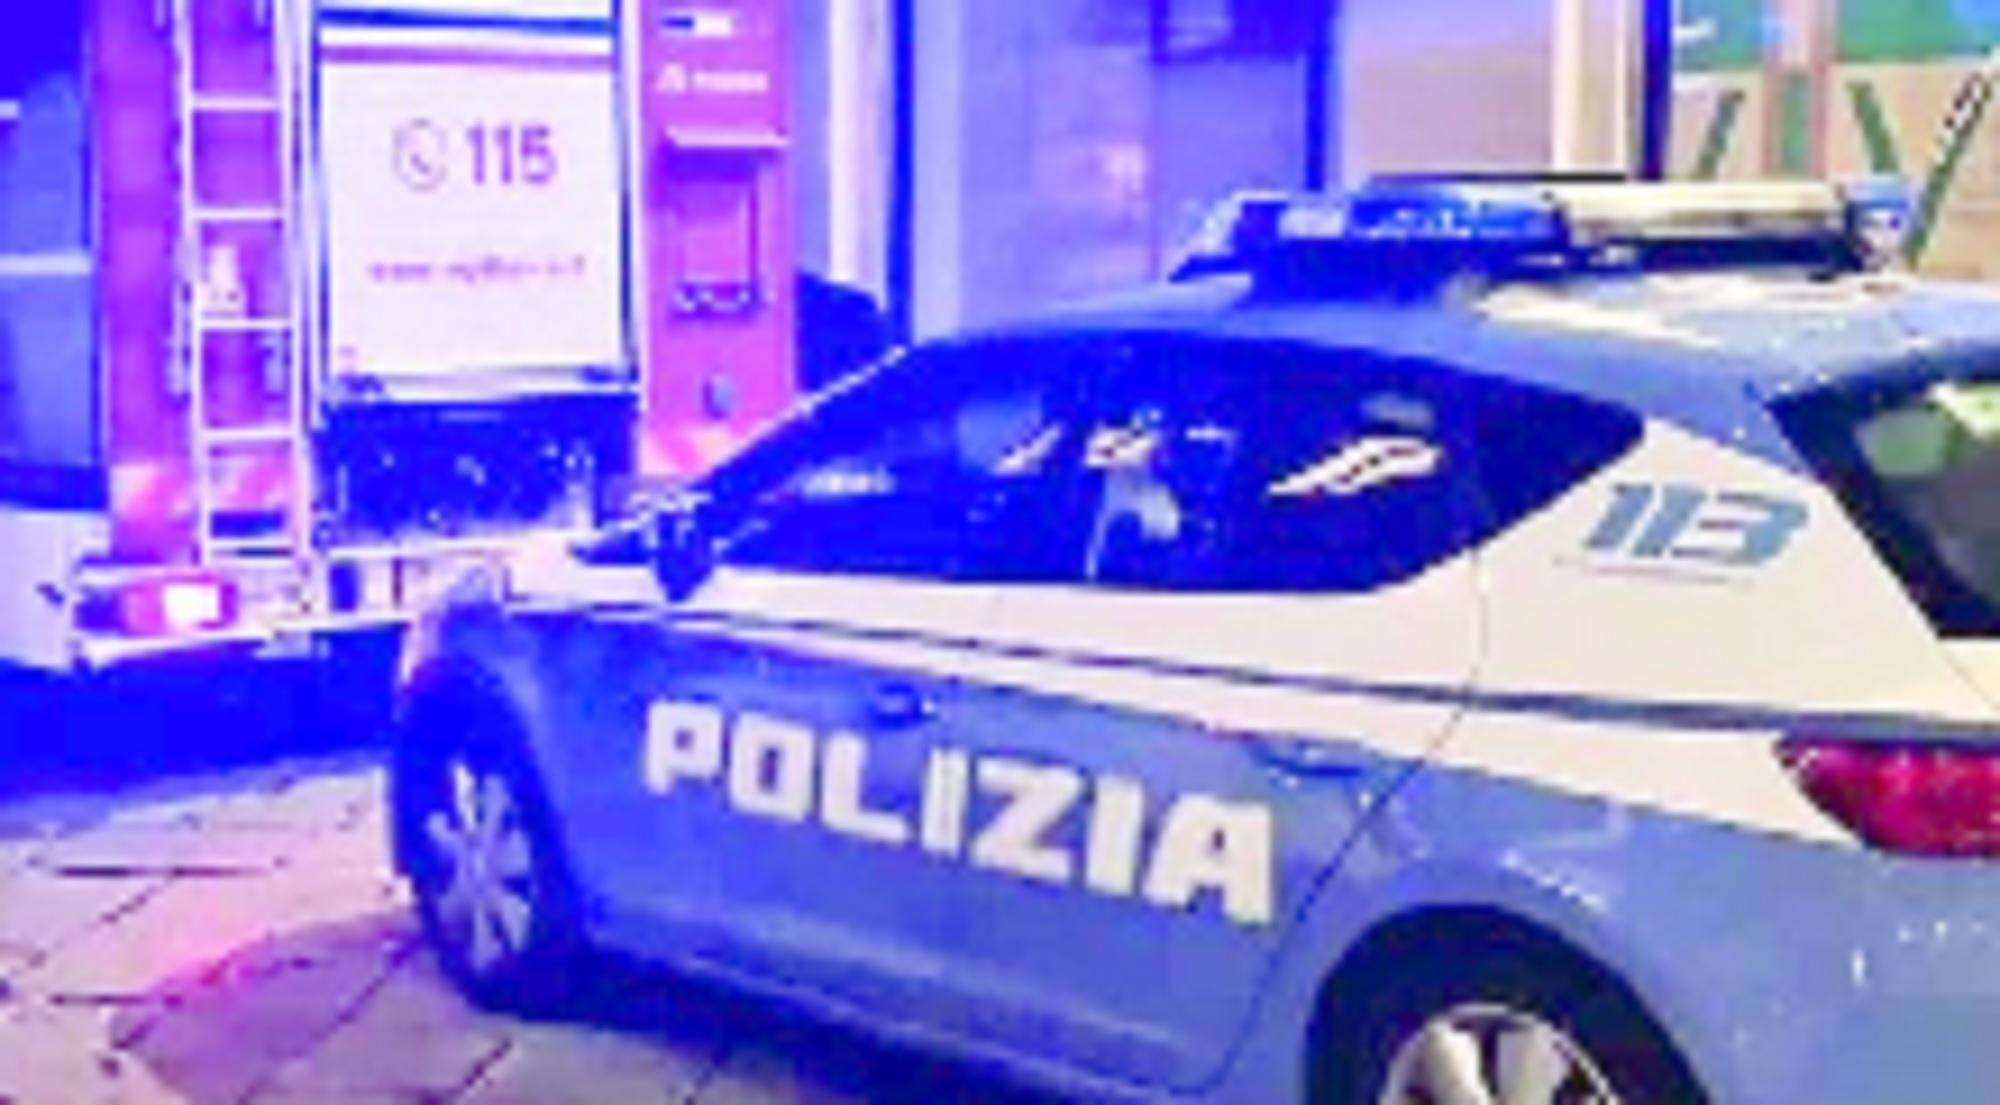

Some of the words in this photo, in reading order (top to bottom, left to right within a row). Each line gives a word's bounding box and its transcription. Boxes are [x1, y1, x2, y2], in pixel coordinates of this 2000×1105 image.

[465, 124, 557, 185] 115
[1583, 482, 1808, 566] 113
[643, 699, 1276, 926] POLIZIA
